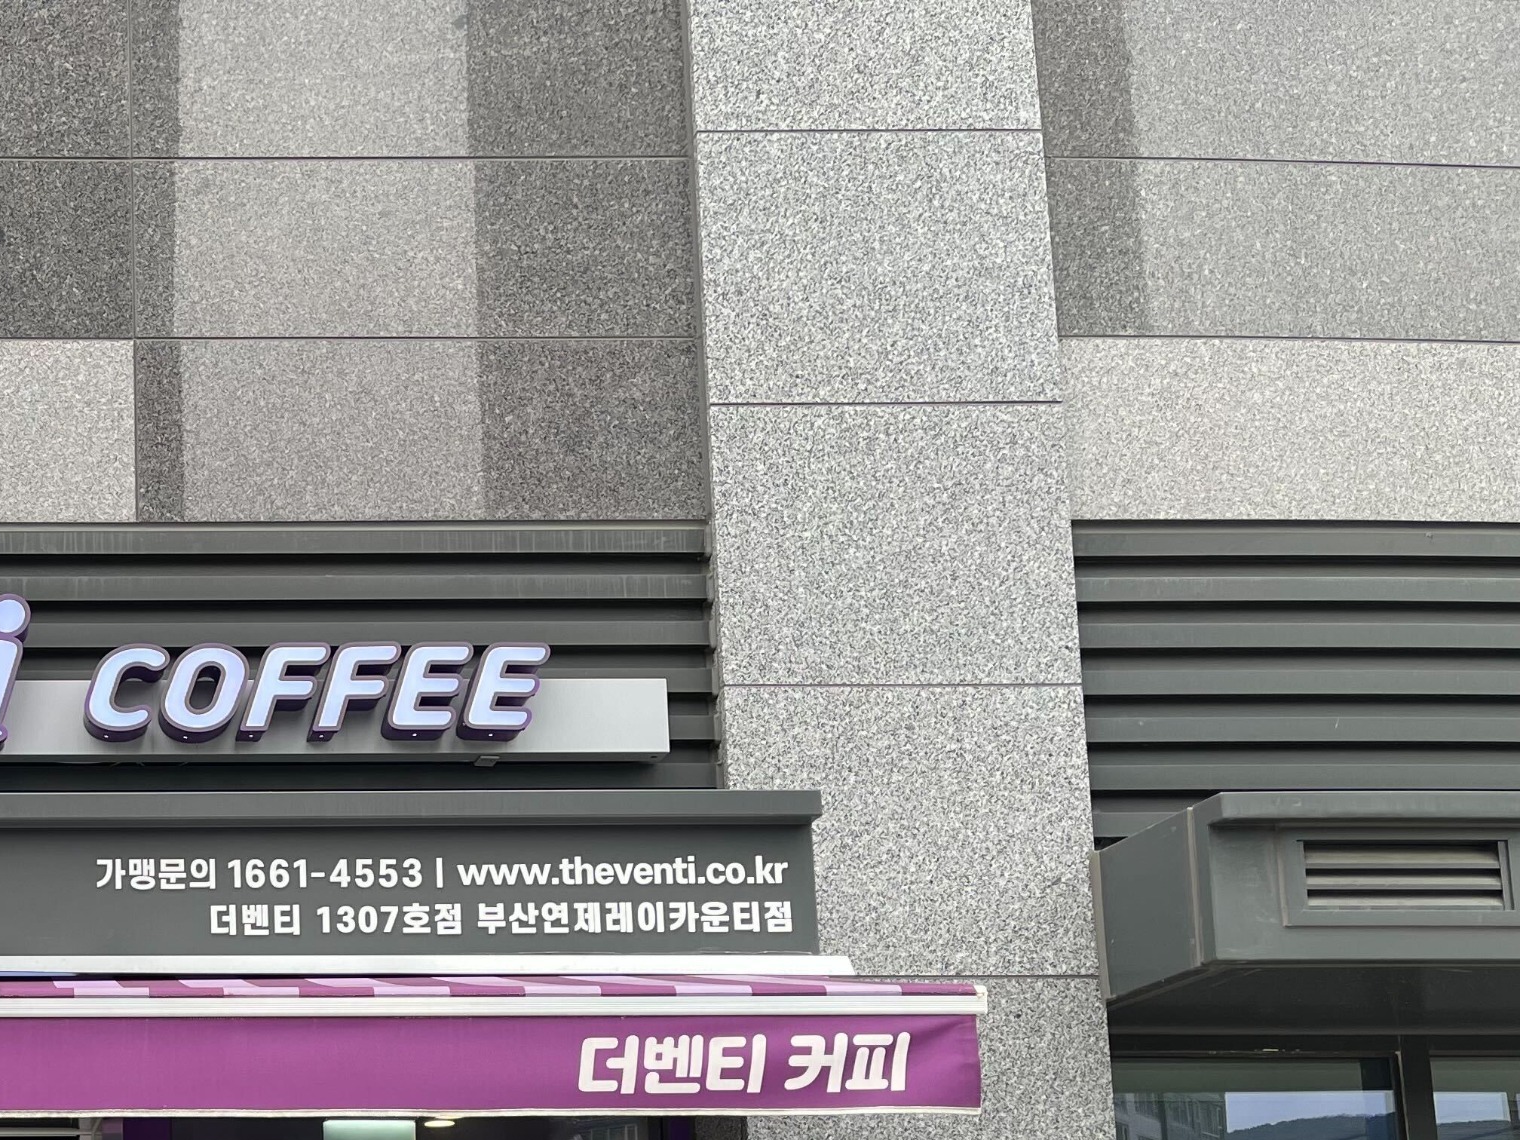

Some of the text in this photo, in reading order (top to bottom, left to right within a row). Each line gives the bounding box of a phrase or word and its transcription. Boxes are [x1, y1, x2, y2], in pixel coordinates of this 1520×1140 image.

[85, 643, 549, 740] COFFEE
[96, 857, 217, 889] 가맹문의
[227, 858, 424, 889] 1661-4553
[457, 855, 788, 886] www.theventi.co.kr
[210, 902, 794, 936] 더벤티 1307호점 부산연제레이카운티점
[578, 1031, 911, 1094] 더벤티 커피
